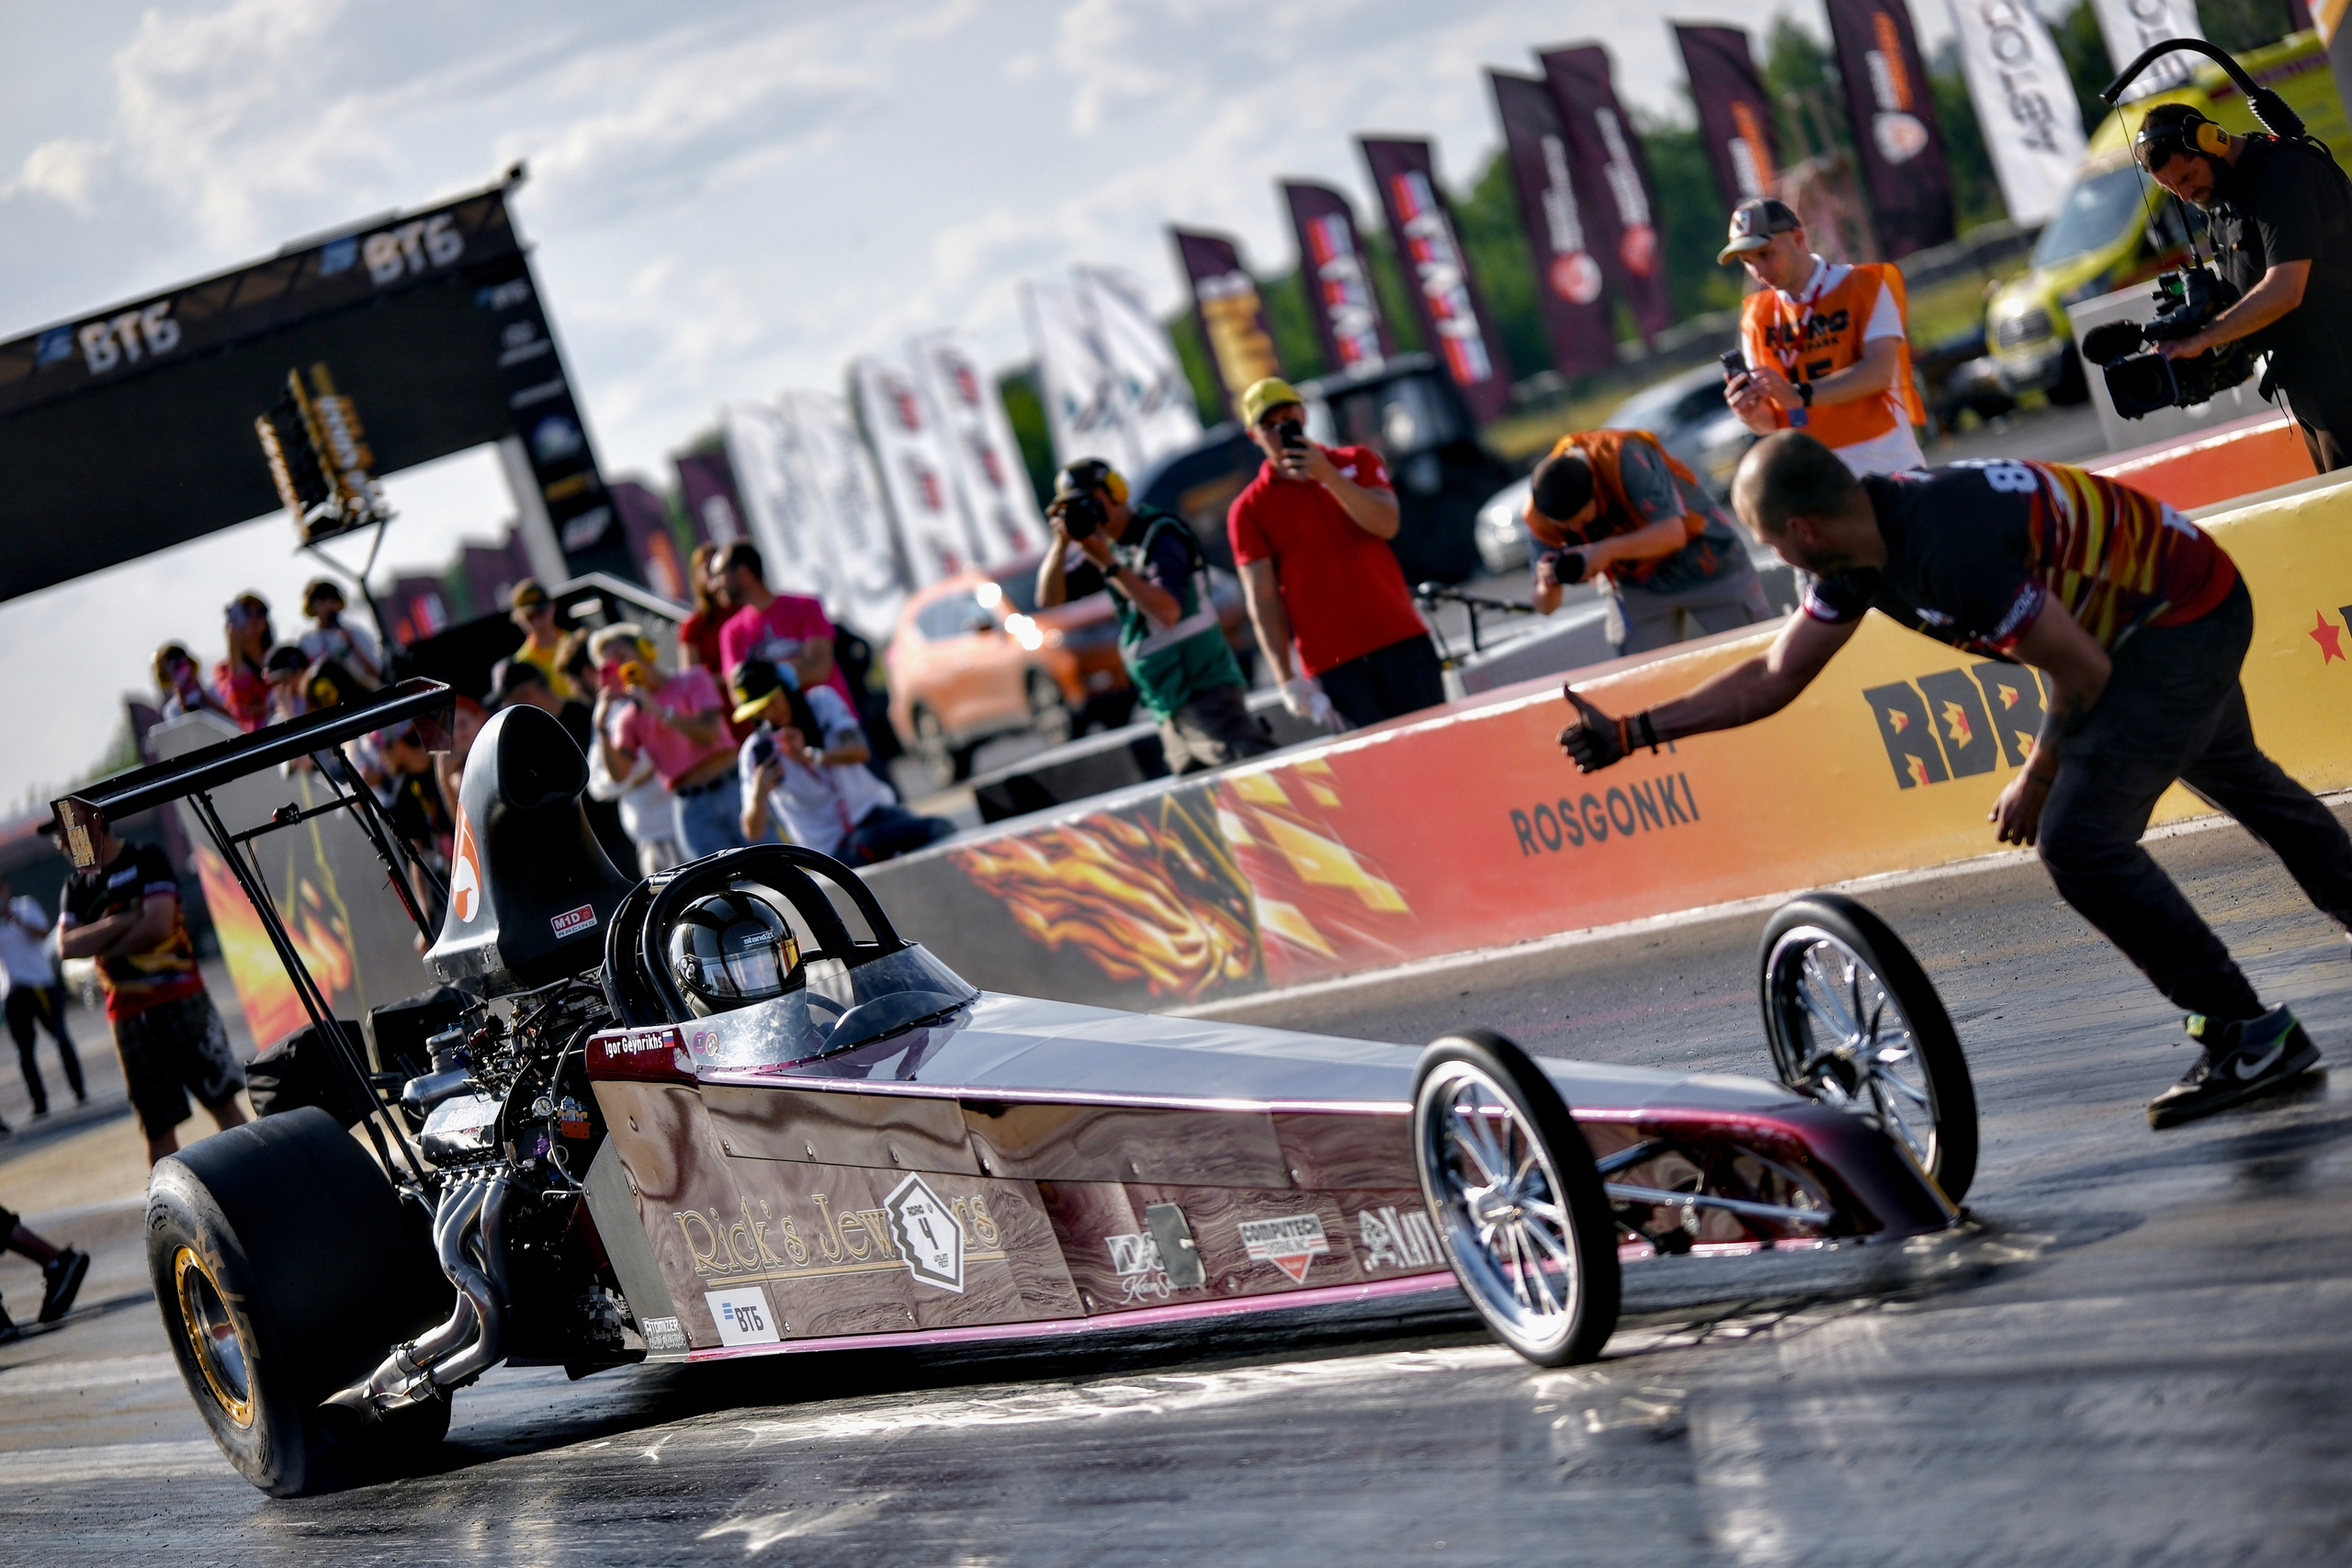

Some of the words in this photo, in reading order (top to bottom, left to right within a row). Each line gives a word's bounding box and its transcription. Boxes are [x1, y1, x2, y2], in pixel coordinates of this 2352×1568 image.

[363, 212, 465, 285] ВТБ
[79, 300, 181, 375] ВТБ
[1862, 660, 2054, 790] RDR
[1510, 771, 1700, 856] ROSGONKI
[553, 912, 581, 931] M1D
[558, 919, 595, 937] RACING
[743, 931, 774, 944] stand21
[605, 1039, 621, 1058] Igor
[621, 1033, 663, 1055] Geynrikhs
[673, 1195, 809, 1277] Rick's
[811, 1193, 1002, 1264] Jewrs
[918, 1216, 939, 1250] 4
[1240, 1216, 1322, 1243] COMPUTECH
[734, 1305, 765, 1333] ВТБ
